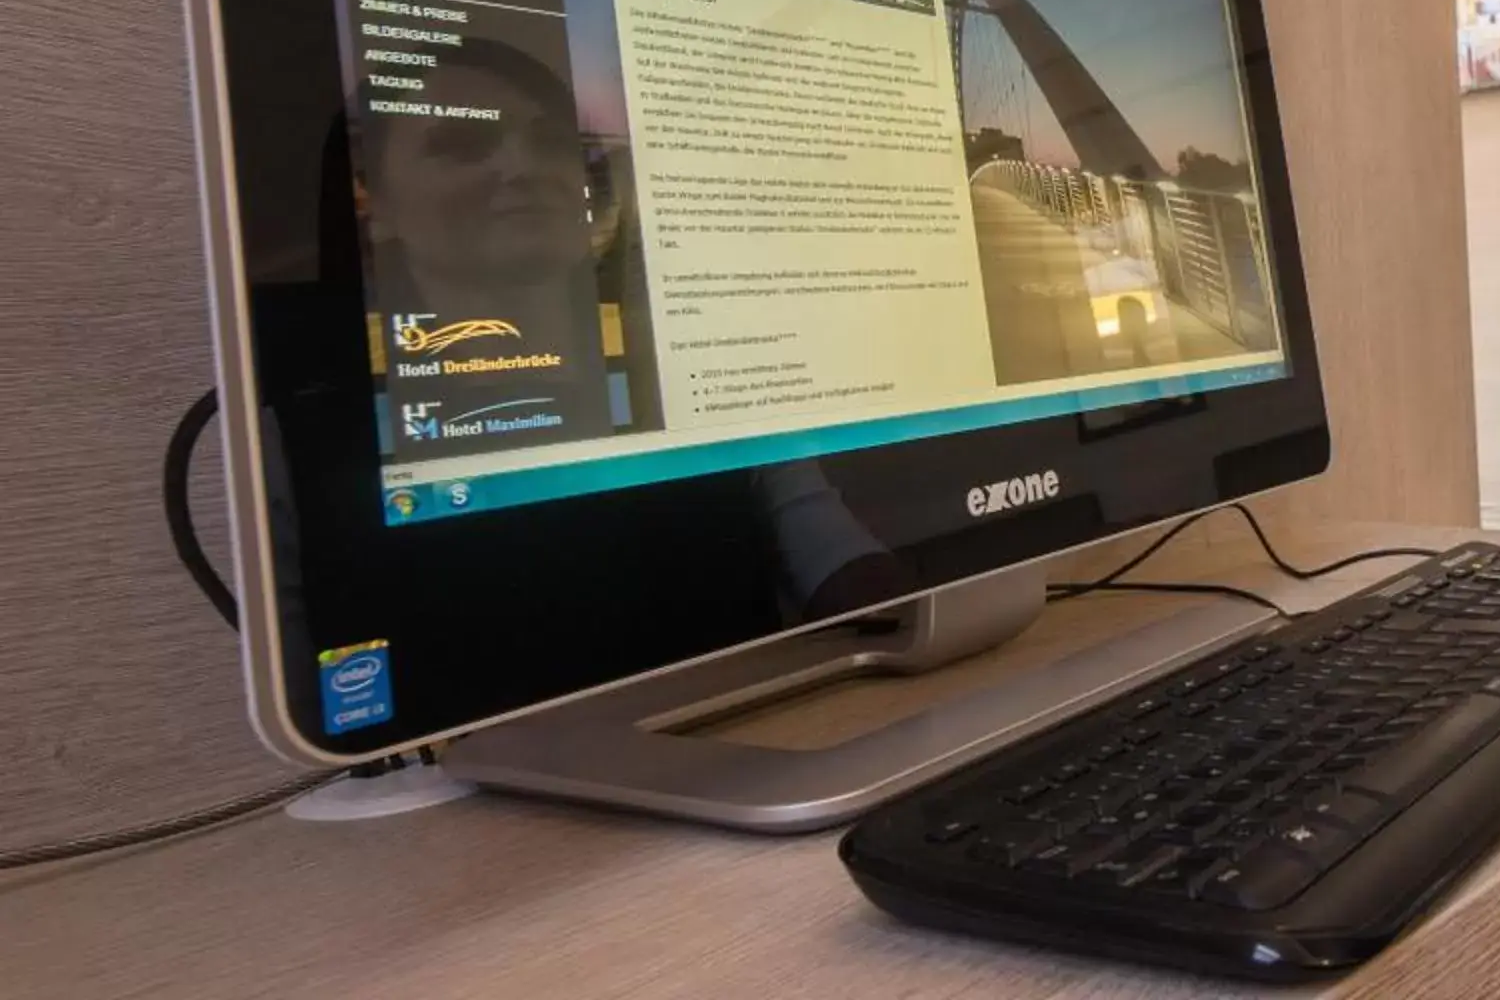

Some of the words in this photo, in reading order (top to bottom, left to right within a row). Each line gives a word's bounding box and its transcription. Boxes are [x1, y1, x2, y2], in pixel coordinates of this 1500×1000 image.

[412, 5, 422, 17] &
[364, 49, 438, 67] ANGEBOTE
[368, 74, 425, 90] TAGUNG
[369, 100, 431, 116] KONTAKT
[433, 105, 444, 117] &
[397, 361, 440, 377] Hotel
[442, 421, 483, 438] Hotel
[486, 413, 563, 432] Maximilian
[967, 469, 1060, 517] exone
